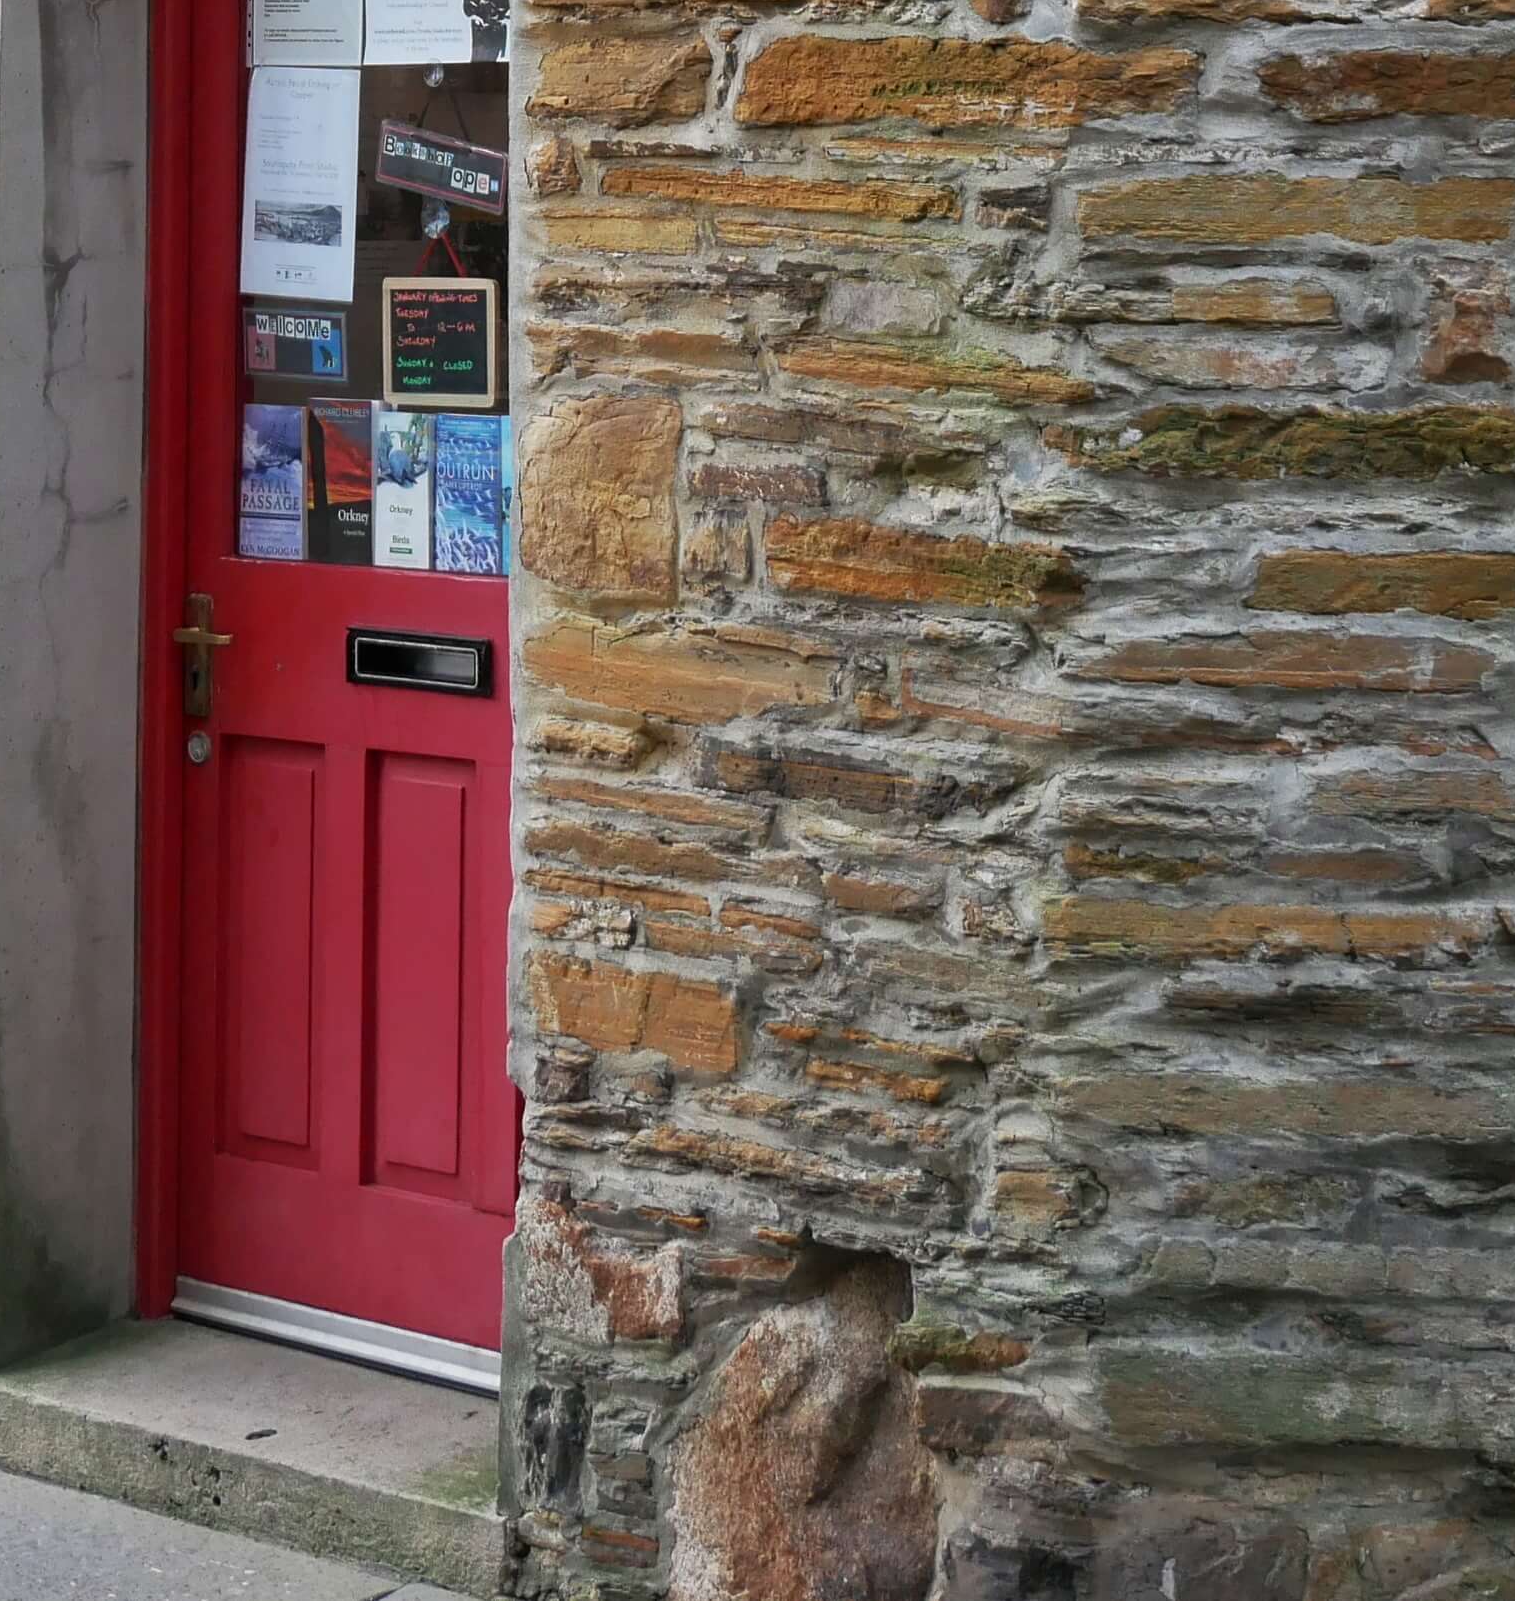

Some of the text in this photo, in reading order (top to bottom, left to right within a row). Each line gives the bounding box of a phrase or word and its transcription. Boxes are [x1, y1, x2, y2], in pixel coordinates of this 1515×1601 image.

[443, 360, 473, 371] CLOSED
[437, 462, 495, 481] OUTRUN
[250, 479, 291, 495] FATAL
[242, 493, 300, 511] PASSAGE
[389, 504, 413, 516] Orkney
[338, 508, 369, 525] Orkney
[392, 535, 410, 544] Birds
